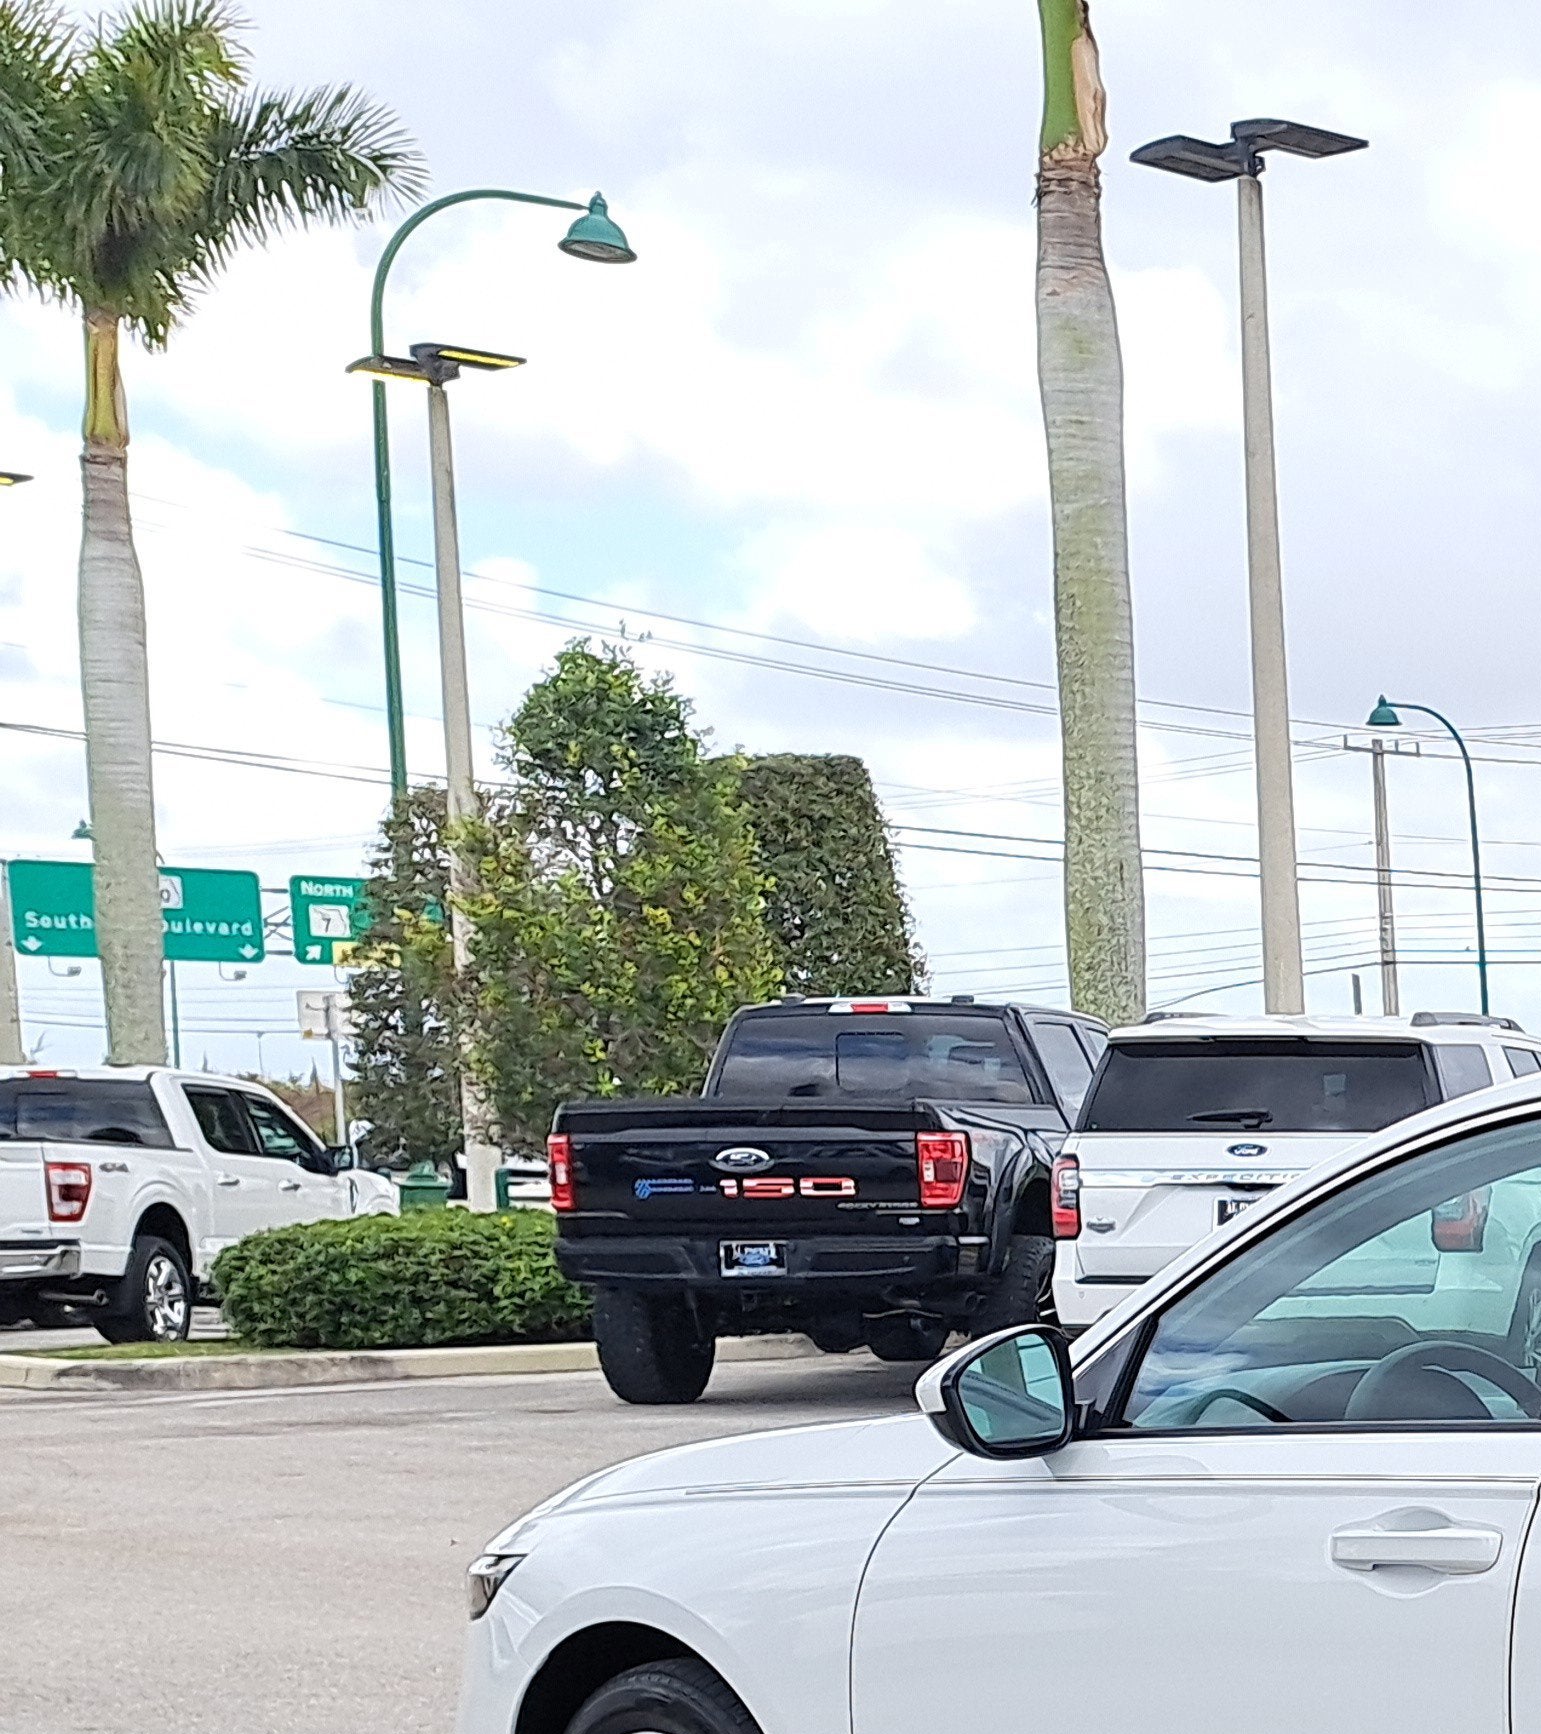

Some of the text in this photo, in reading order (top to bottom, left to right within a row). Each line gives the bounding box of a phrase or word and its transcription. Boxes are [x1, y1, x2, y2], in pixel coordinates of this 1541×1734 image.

[301, 880, 354, 898] NORTH
[24, 911, 94, 929] South
[321, 917, 332, 933] 7
[634, 1177, 857, 1199] F-150
